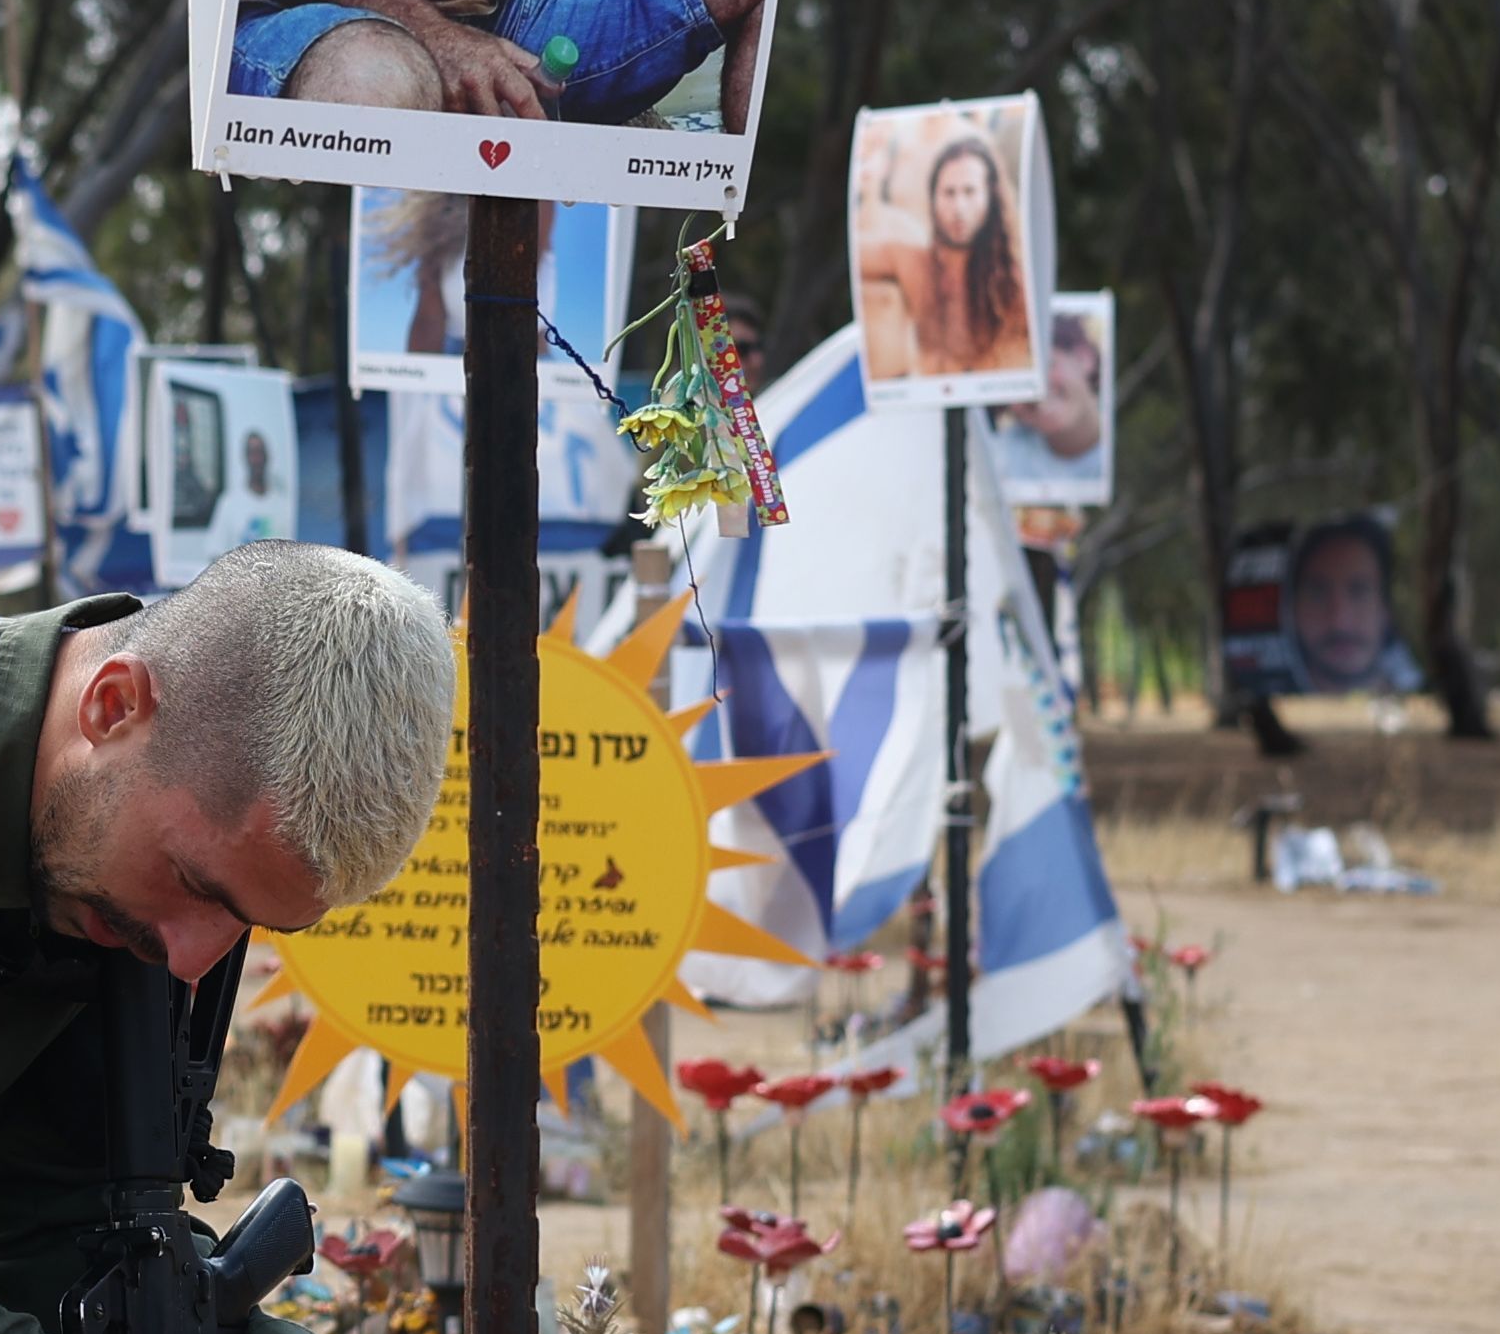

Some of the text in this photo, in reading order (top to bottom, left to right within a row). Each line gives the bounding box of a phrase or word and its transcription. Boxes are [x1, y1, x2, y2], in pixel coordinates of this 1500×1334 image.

[225, 120, 392, 155] Ilan Avraham
[627, 157, 735, 182] אילן אברהם
[733, 406, 775, 504] Ilan Avraham
[591, 732, 648, 766] עדן
[410, 972, 467, 994] זכור
